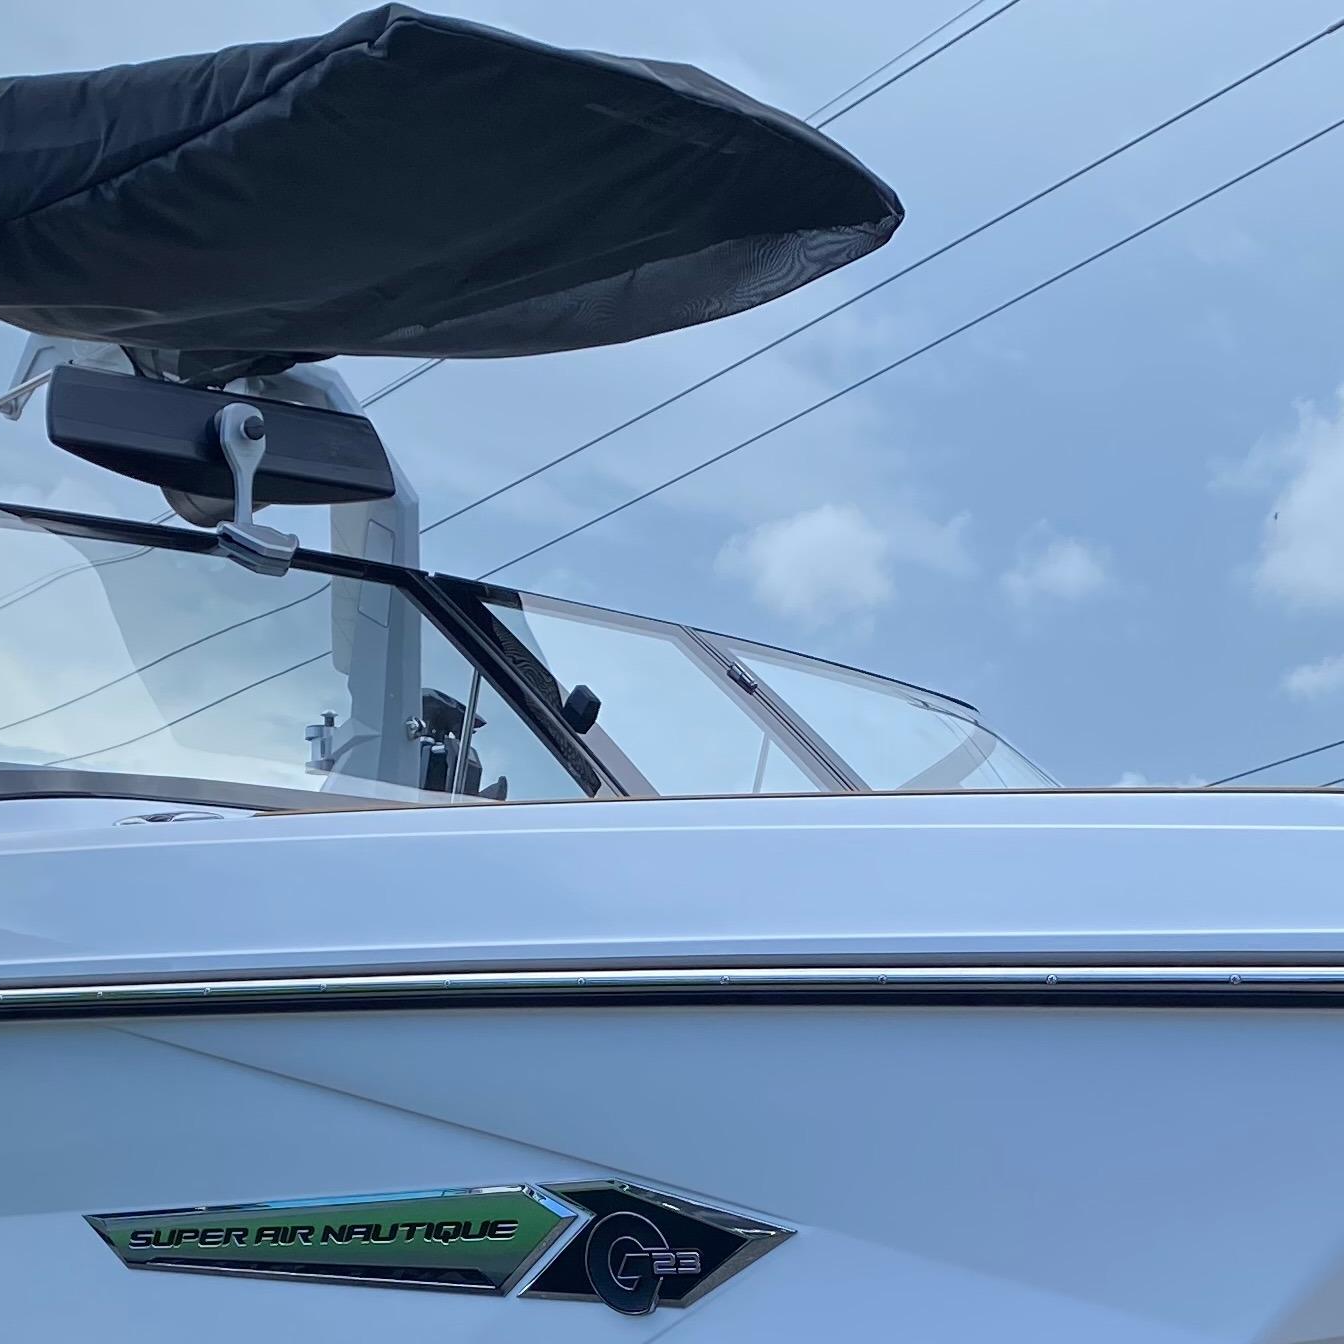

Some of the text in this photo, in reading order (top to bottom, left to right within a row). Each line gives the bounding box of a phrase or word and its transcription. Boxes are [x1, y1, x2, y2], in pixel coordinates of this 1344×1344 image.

[129, 1219, 519, 1249] SUPER AIR NAUTIQUE
